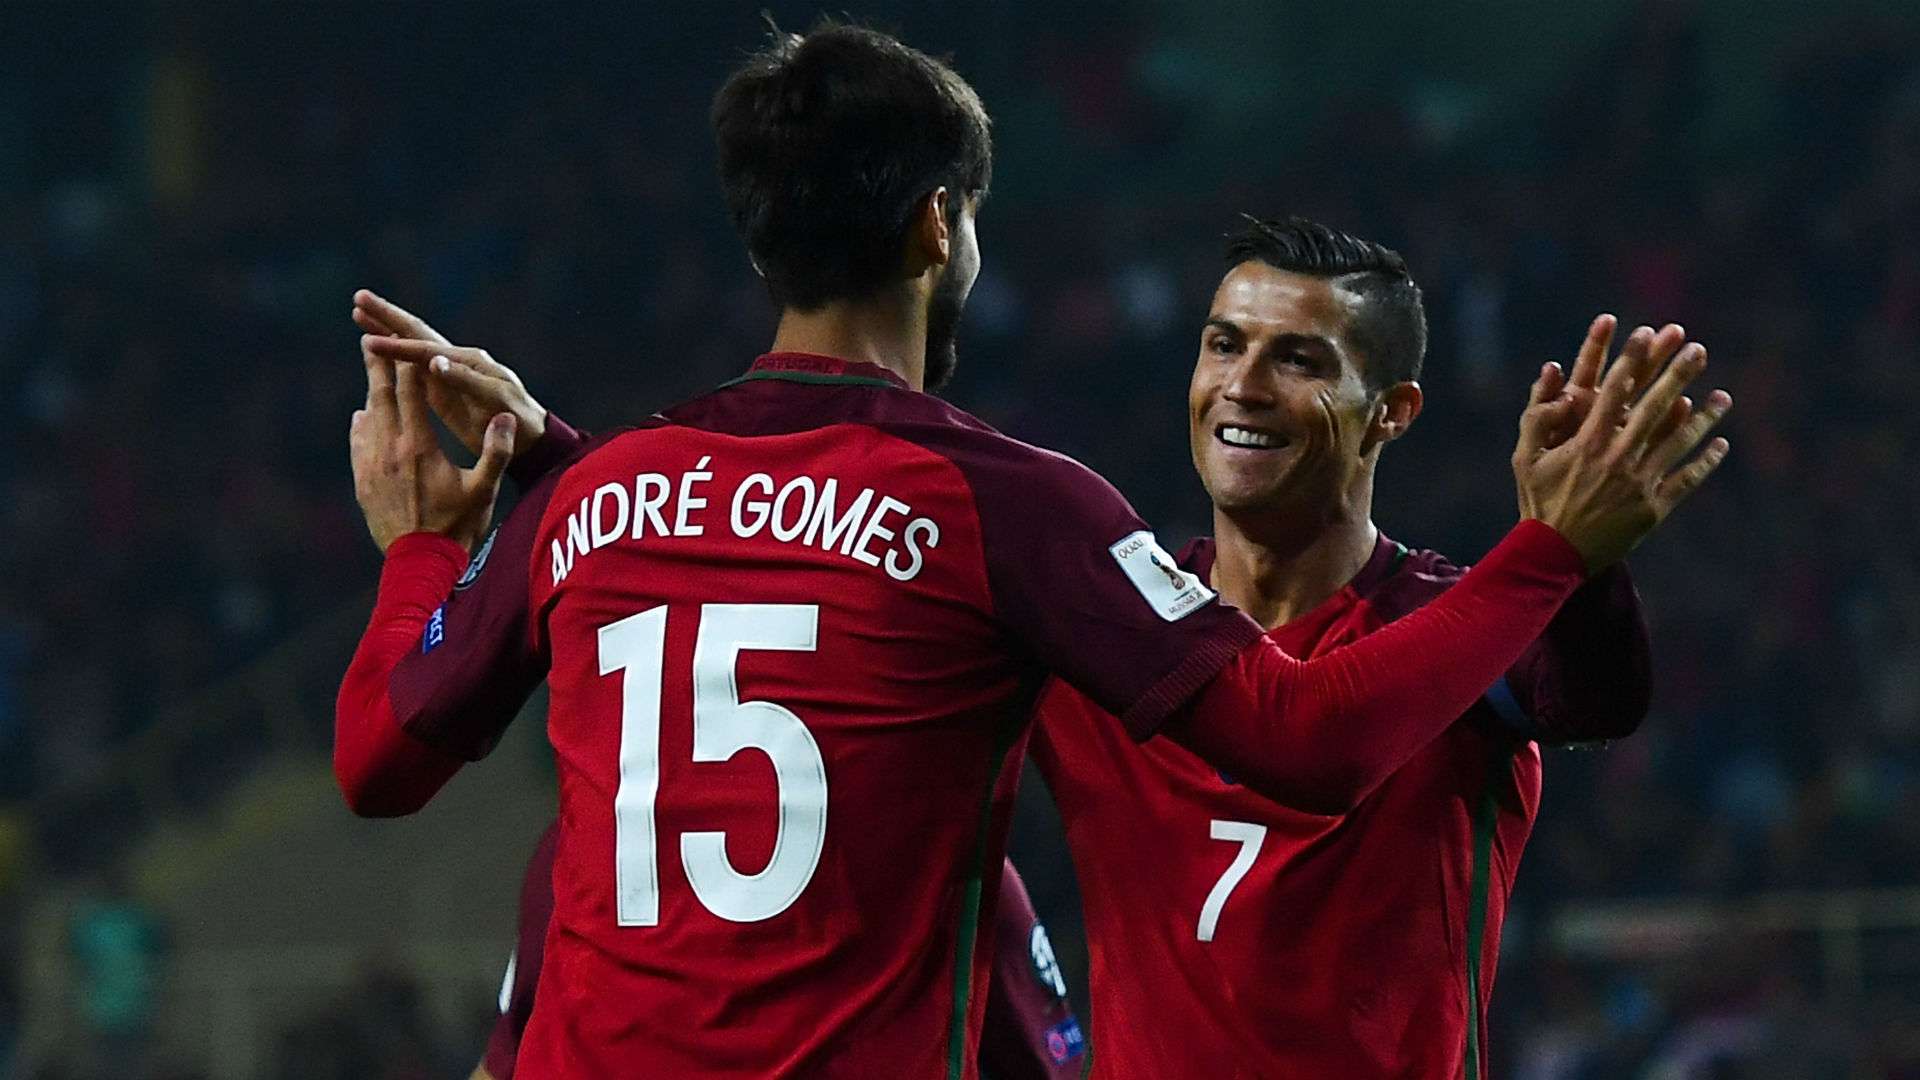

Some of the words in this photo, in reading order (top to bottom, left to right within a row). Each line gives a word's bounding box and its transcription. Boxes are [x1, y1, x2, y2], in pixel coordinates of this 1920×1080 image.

[551, 456, 713, 587] ANDRÉ
[730, 473, 940, 581] GOMES
[597, 604, 828, 927] 15
[1197, 819, 1267, 942] 7
